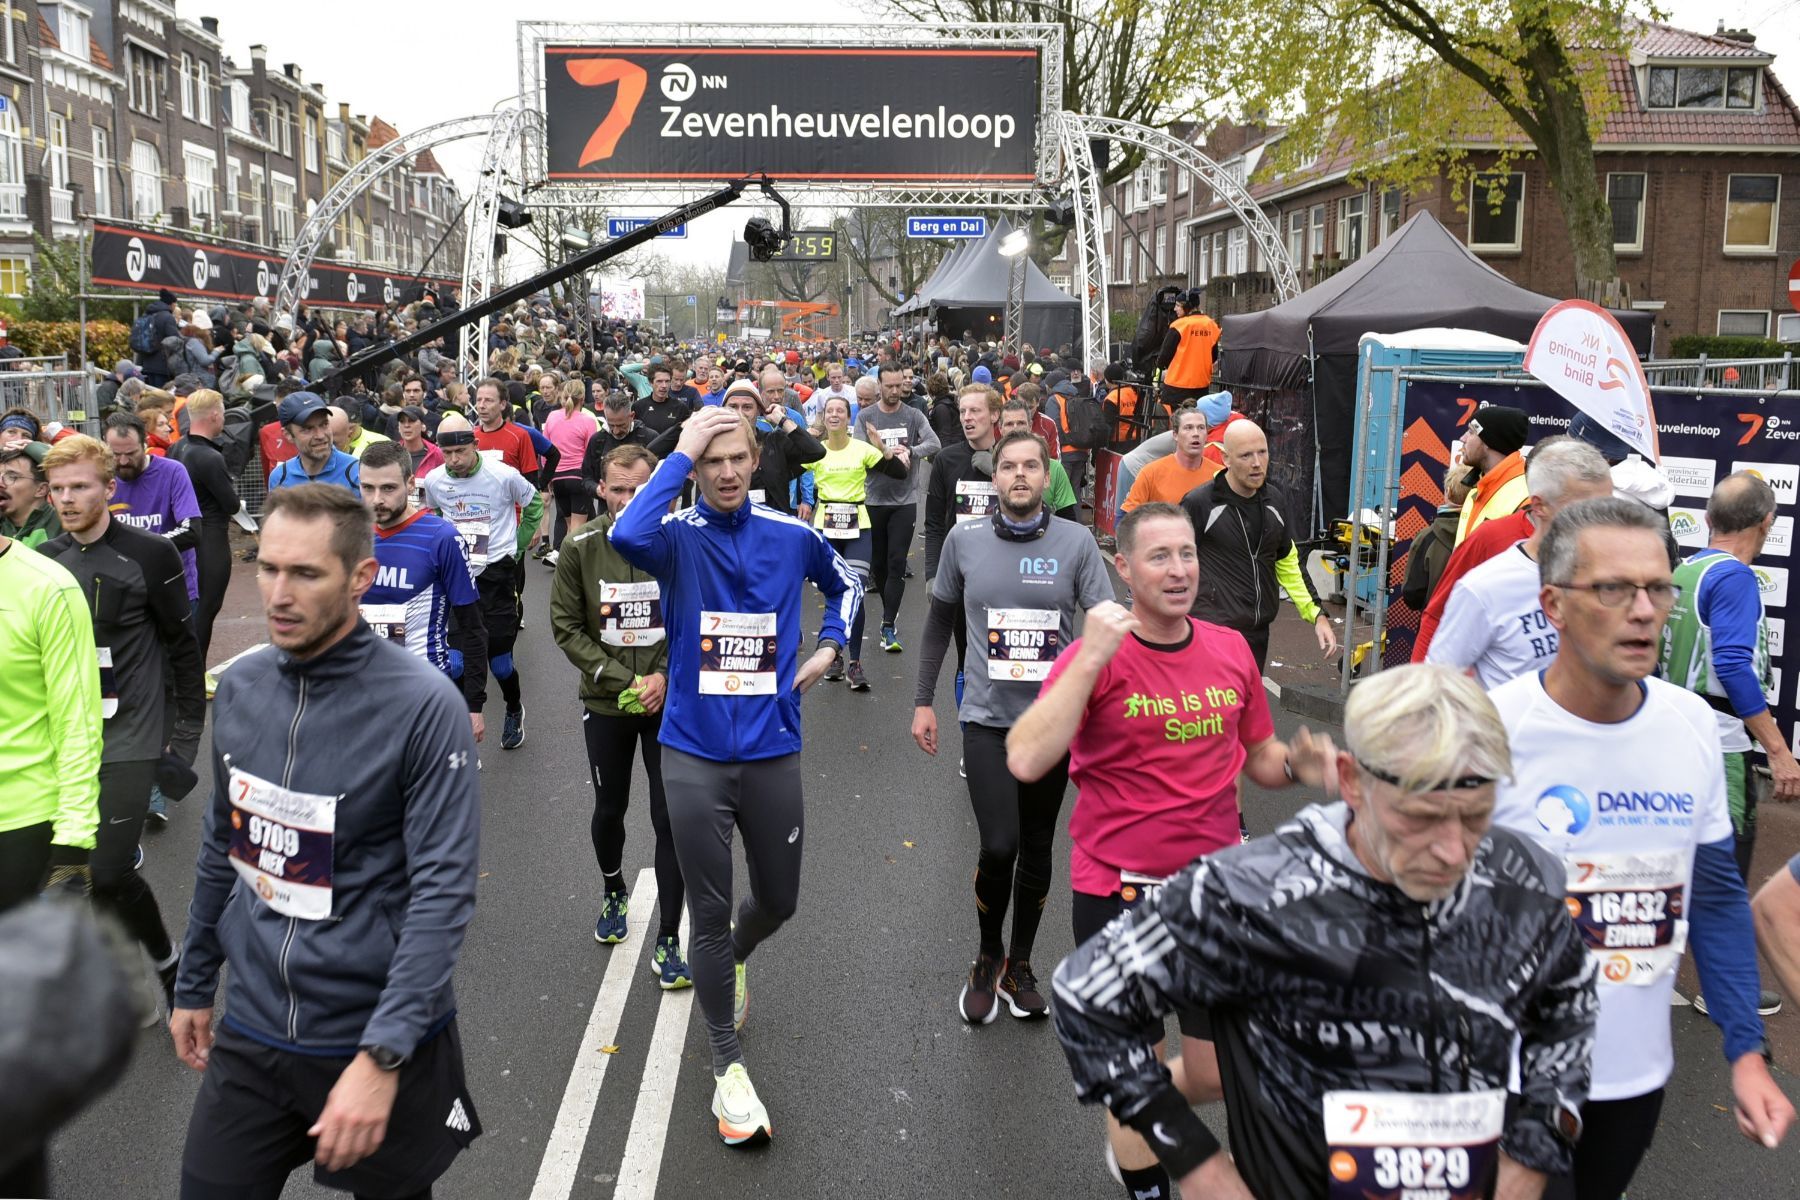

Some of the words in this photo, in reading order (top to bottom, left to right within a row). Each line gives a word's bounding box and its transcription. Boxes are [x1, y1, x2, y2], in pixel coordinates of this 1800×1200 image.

[701, 75, 728, 89] NN
[565, 58, 648, 169] 7
[660, 104, 1016, 148] Zevenheuvelenloop
[913, 221, 939, 234] Berg
[943, 223, 958, 232] en
[960, 221, 979, 232] Dal
[147, 254, 162, 271] NN
[209, 263, 220, 279] NN
[1668, 476, 1707, 486] elderland
[1769, 478, 1793, 490] NN
[968, 495, 989, 506] 7756
[114, 513, 162, 531] Pluryn
[1674, 518, 1690, 530] AA
[618, 601, 651, 617] 1295
[620, 616, 651, 629] JEROEN
[717, 636, 764, 656] 17298
[1002, 629, 1045, 647] 16079
[1008, 647, 1040, 660] DENNIS
[719, 656, 761, 671] LENNART
[1180, 690, 1202, 712] is
[1205, 685, 1238, 708] the
[1165, 713, 1224, 744] Spirit
[248, 815, 300, 857] 9709
[1587, 890, 1668, 924] 16432
[1373, 1146, 1470, 1189] 3829
